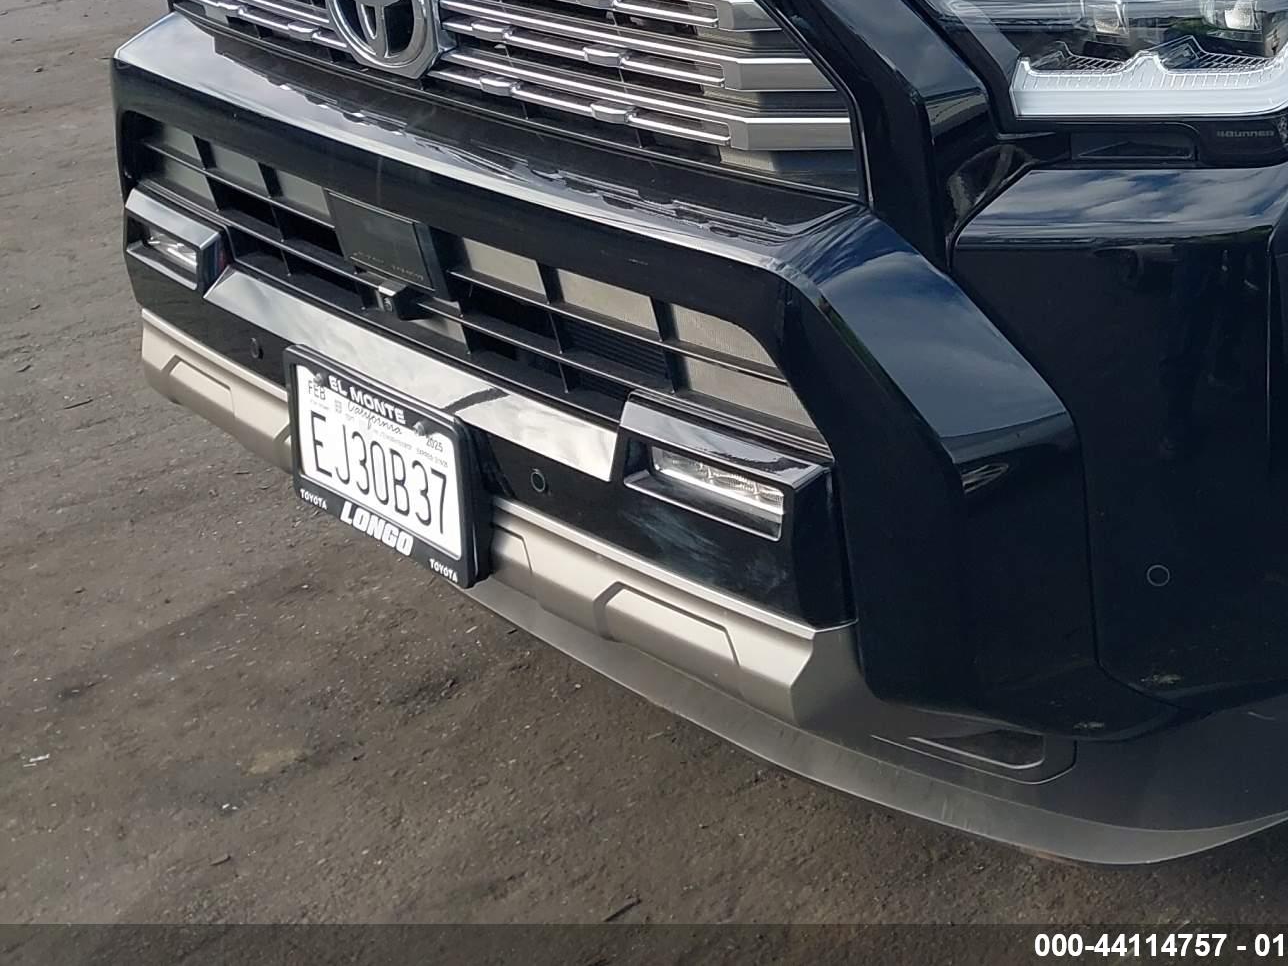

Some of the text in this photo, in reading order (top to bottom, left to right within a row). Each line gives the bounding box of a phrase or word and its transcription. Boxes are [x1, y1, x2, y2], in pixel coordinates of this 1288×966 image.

[308, 380, 326, 401] FEB
[328, 375, 347, 396] EL
[350, 387, 406, 425] MONTE
[310, 410, 447, 535] EJ30B37
[300, 488, 328, 511] TOYOTA
[339, 500, 414, 557] LONGO
[429, 558, 458, 584] TOYOTA
